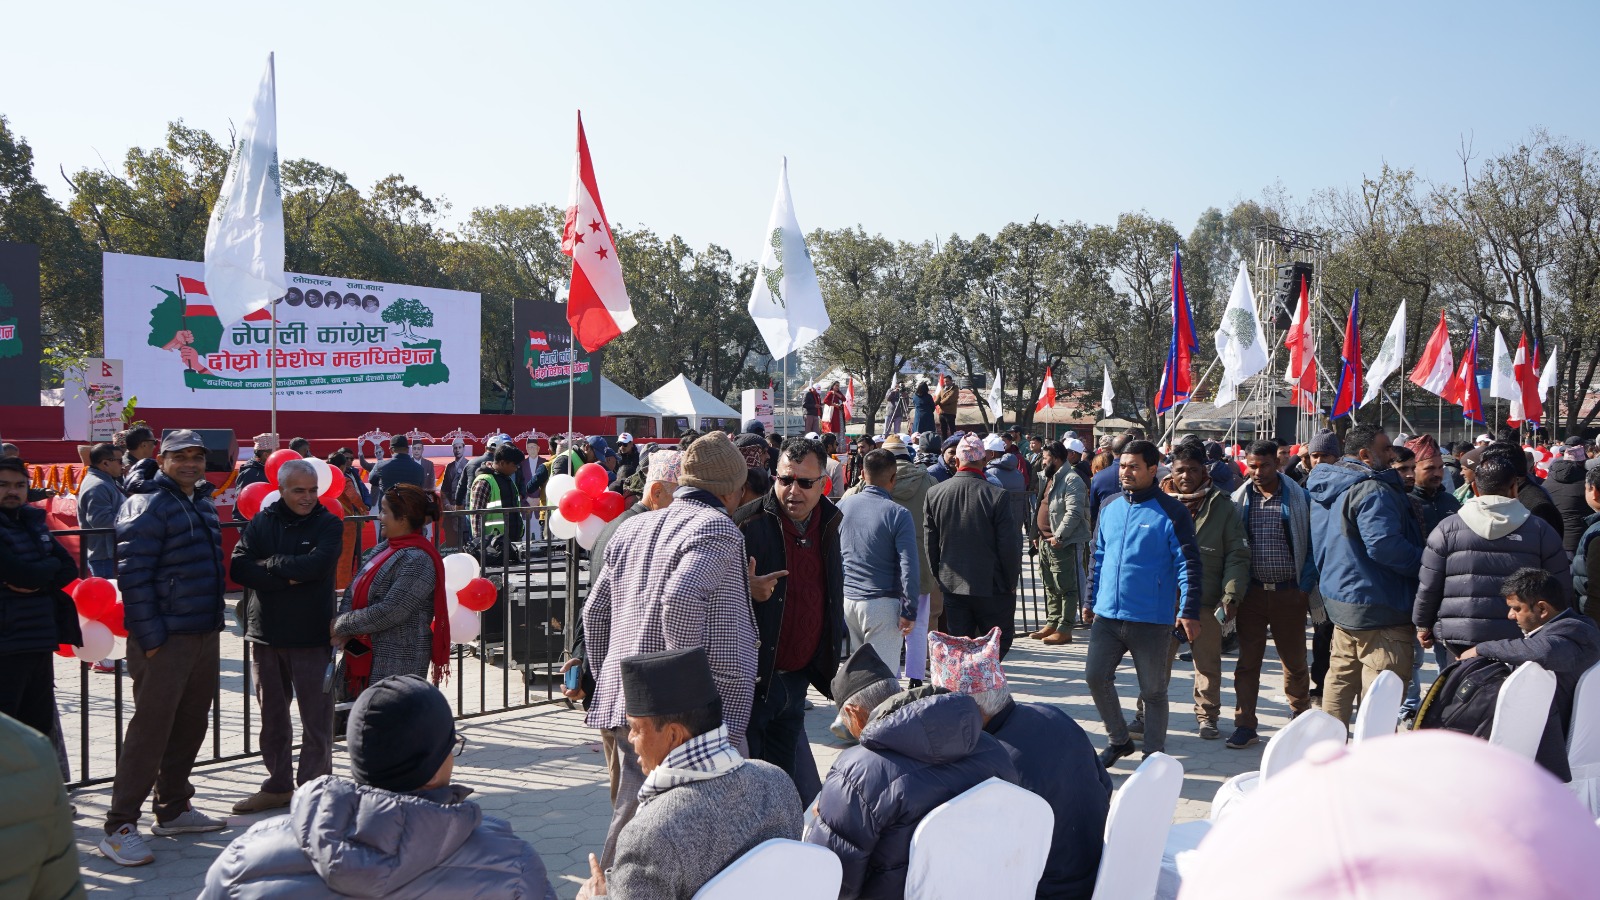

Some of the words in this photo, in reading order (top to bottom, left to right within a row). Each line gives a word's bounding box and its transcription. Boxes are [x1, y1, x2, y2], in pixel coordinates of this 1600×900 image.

[232, 322, 308, 346] नेपली
[317, 321, 388, 345] कांग्रेस
[208, 350, 261, 371] दोस्रो
[266, 349, 327, 368] विशेष
[332, 347, 434, 367] महाधिवेशन
